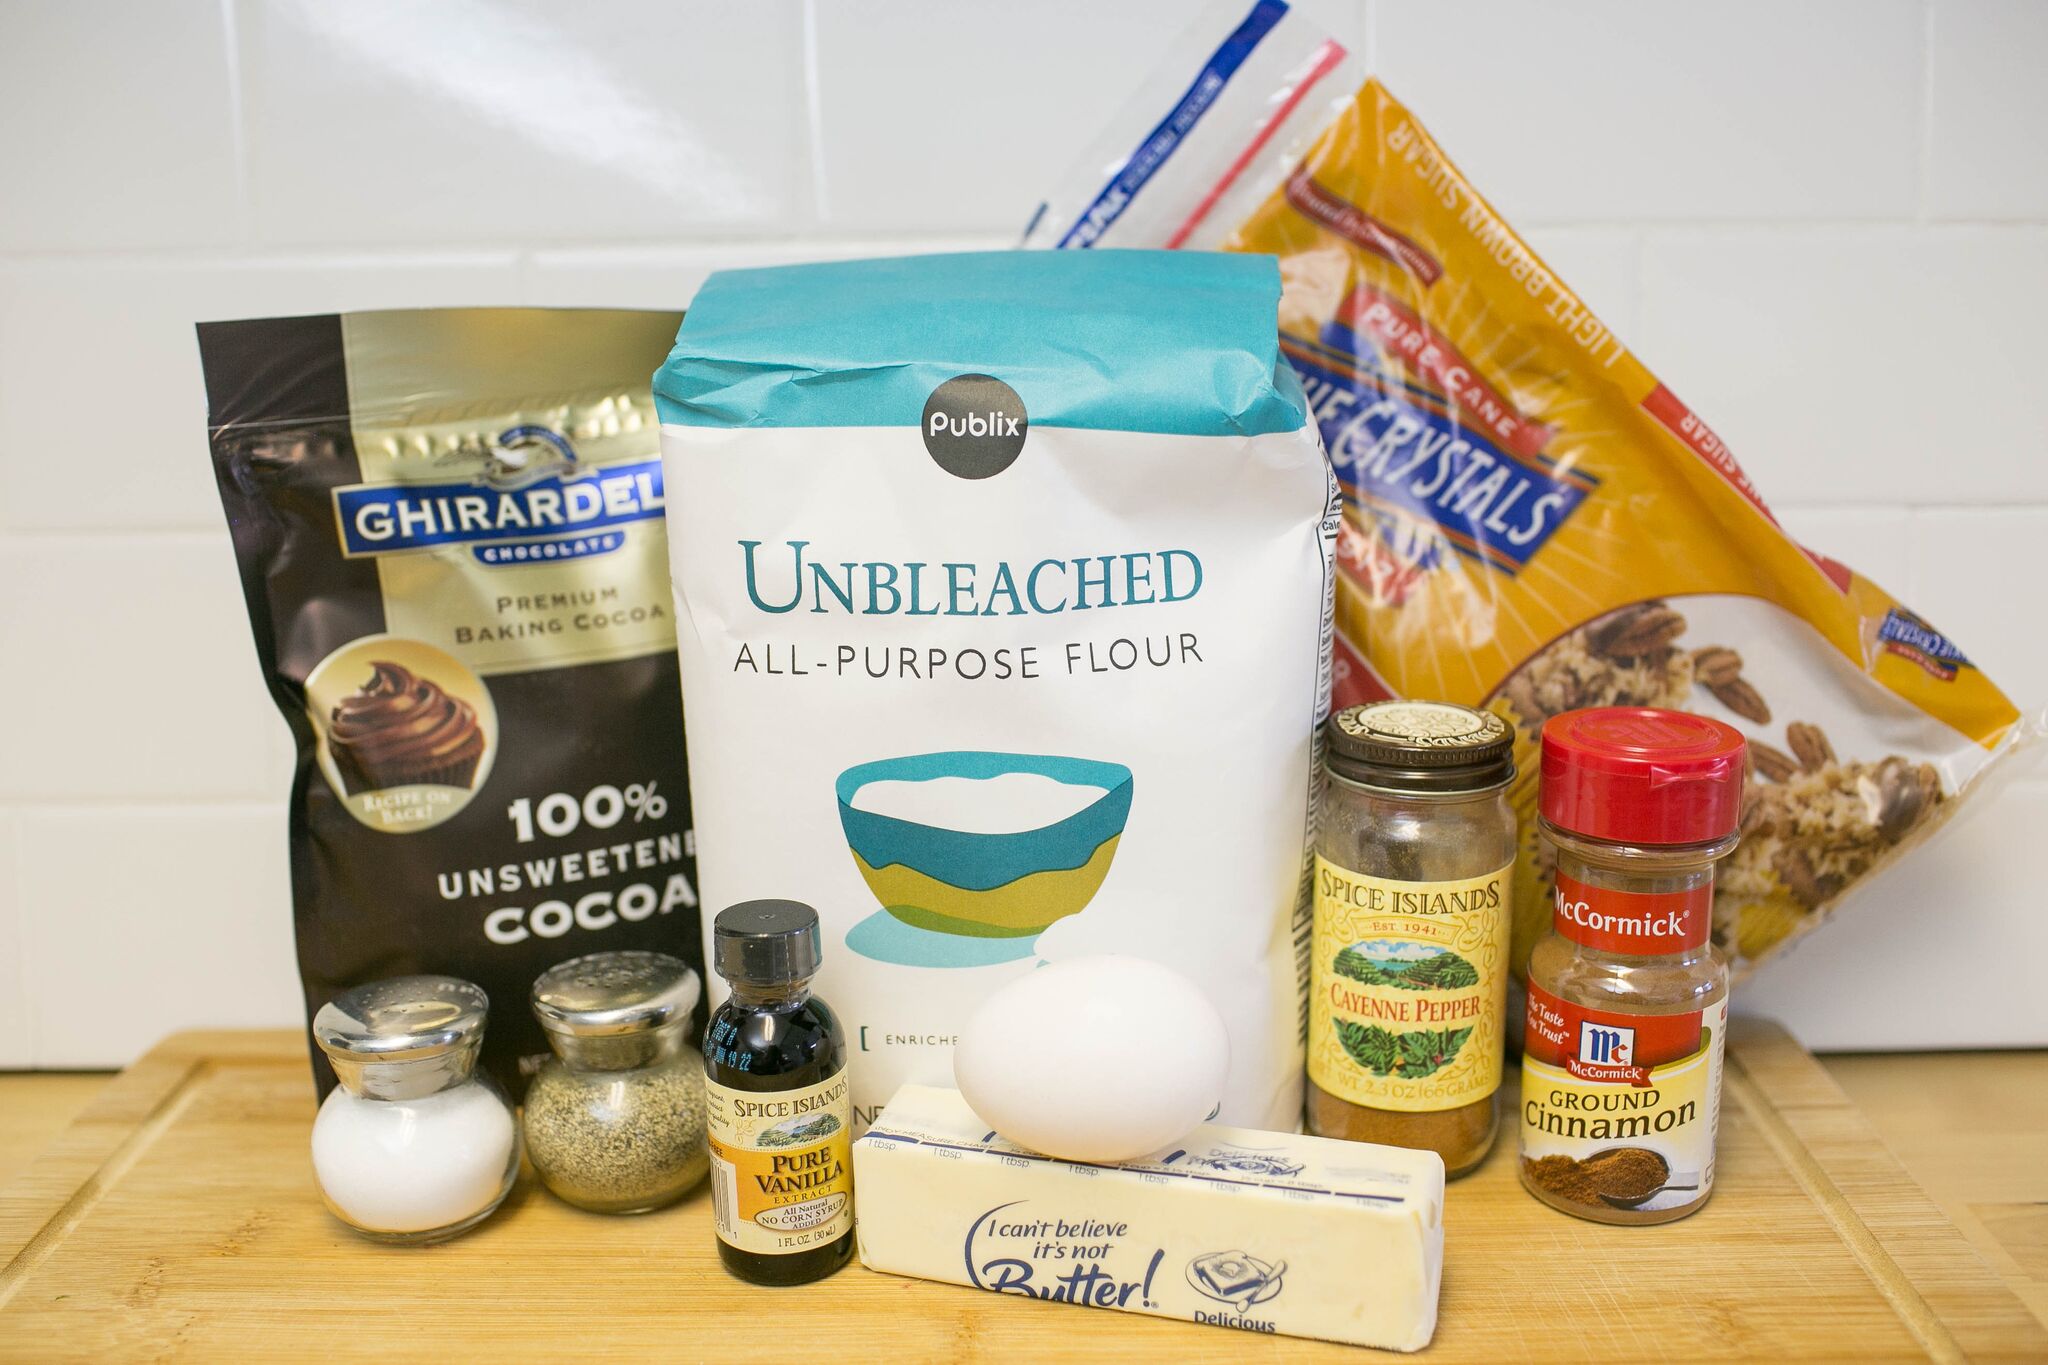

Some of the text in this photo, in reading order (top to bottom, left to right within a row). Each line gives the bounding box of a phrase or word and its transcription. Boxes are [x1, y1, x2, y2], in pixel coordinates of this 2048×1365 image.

[1387, 120, 1462, 209] SUGAR
[1459, 200, 1552, 297] BROWN
[1545, 285, 1628, 368] LIGHT
[1361, 302, 1518, 438] PURE CANE
[930, 411, 1020, 437] Publix
[1329, 399, 1565, 545] CRYSTALS
[355, 472, 664, 541] GHIRARDEL
[484, 535, 616, 562] CHOCOLATE
[737, 540, 1203, 616] UNBLEACHED
[497, 587, 618, 614] PREMIUM
[454, 604, 665, 645] BAKING COCOA
[734, 633, 1203, 679] ALL-PURPOSE FLOUR
[508, 780, 668, 842] 100%
[1321, 869, 1500, 915] SPICE ISLANDS
[483, 873, 698, 945] COCOA
[1404, 924, 1437, 936] 1941
[1331, 982, 1480, 1022] CAYENNE PEPPER
[1539, 1003, 1565, 1027] Taste
[739, 1052, 751, 1071] 22
[734, 1075, 848, 1117] SPICE ISLANDS
[1393, 1085, 1416, 1098] OZ
[1550, 1089, 1661, 1112] GROUND
[1525, 1100, 1696, 1139] Cinnamon
[772, 1146, 831, 1173] PURE
[938, 1148, 963, 1159] tbsp.
[1006, 1157, 1031, 1168] tbsp.
[754, 1160, 843, 1193] VANILLA
[774, 1184, 833, 1204] EXTRACT
[784, 1199, 828, 1216] All Natural
[762, 1198, 843, 1225] NO CORN SYRUP
[792, 1218, 822, 1229] ADDED
[988, 1219, 1128, 1237] I can't believe
[1033, 1241, 1114, 1259] it's not
[1194, 1310, 1276, 1333] Delicious
